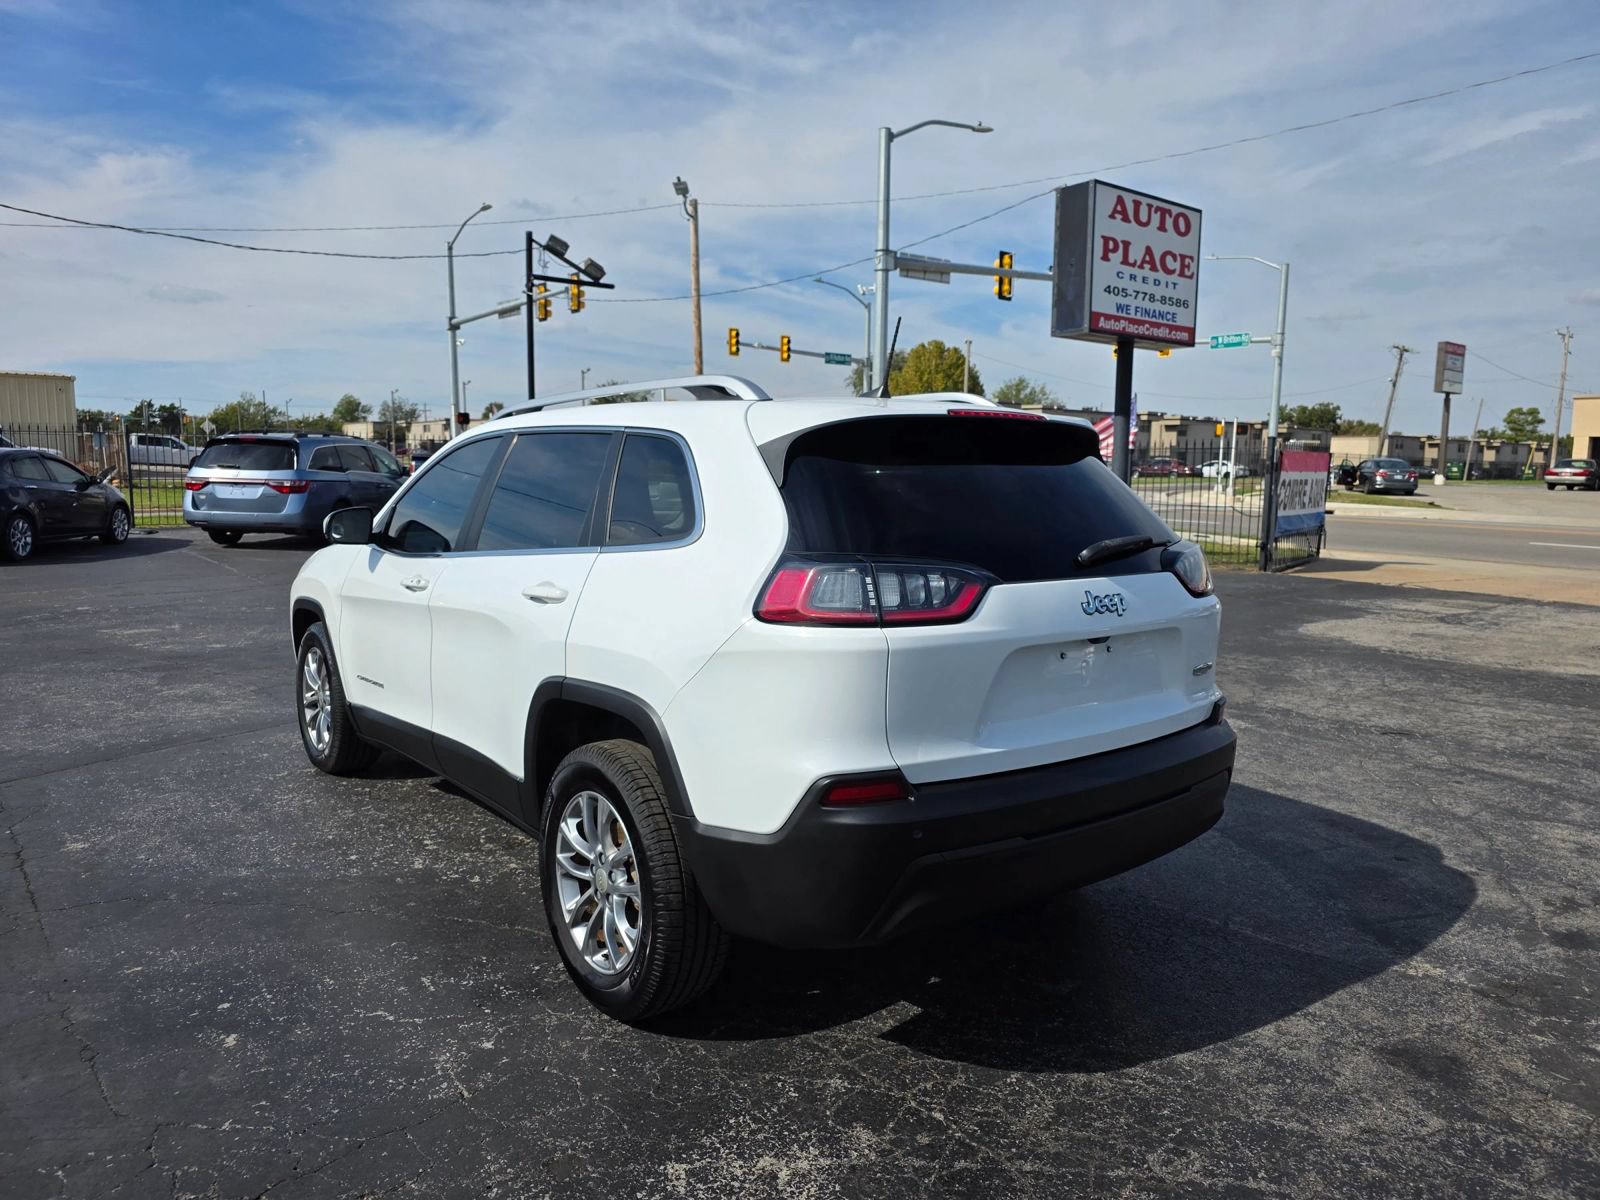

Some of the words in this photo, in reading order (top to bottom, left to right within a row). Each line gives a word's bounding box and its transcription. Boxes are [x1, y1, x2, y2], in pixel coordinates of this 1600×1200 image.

[1108, 195, 1192, 238] AUTO
[1100, 235, 1195, 280] PLACE
[1116, 271, 1180, 290] CREDIT
[1103, 285, 1190, 309] 405-778-8586
[1115, 302, 1131, 316] WE
[1134, 305, 1178, 323] FINANCE
[1098, 317, 1189, 341] AutoPlaceCredit.com
[1081, 590, 1128, 617] Jeep
